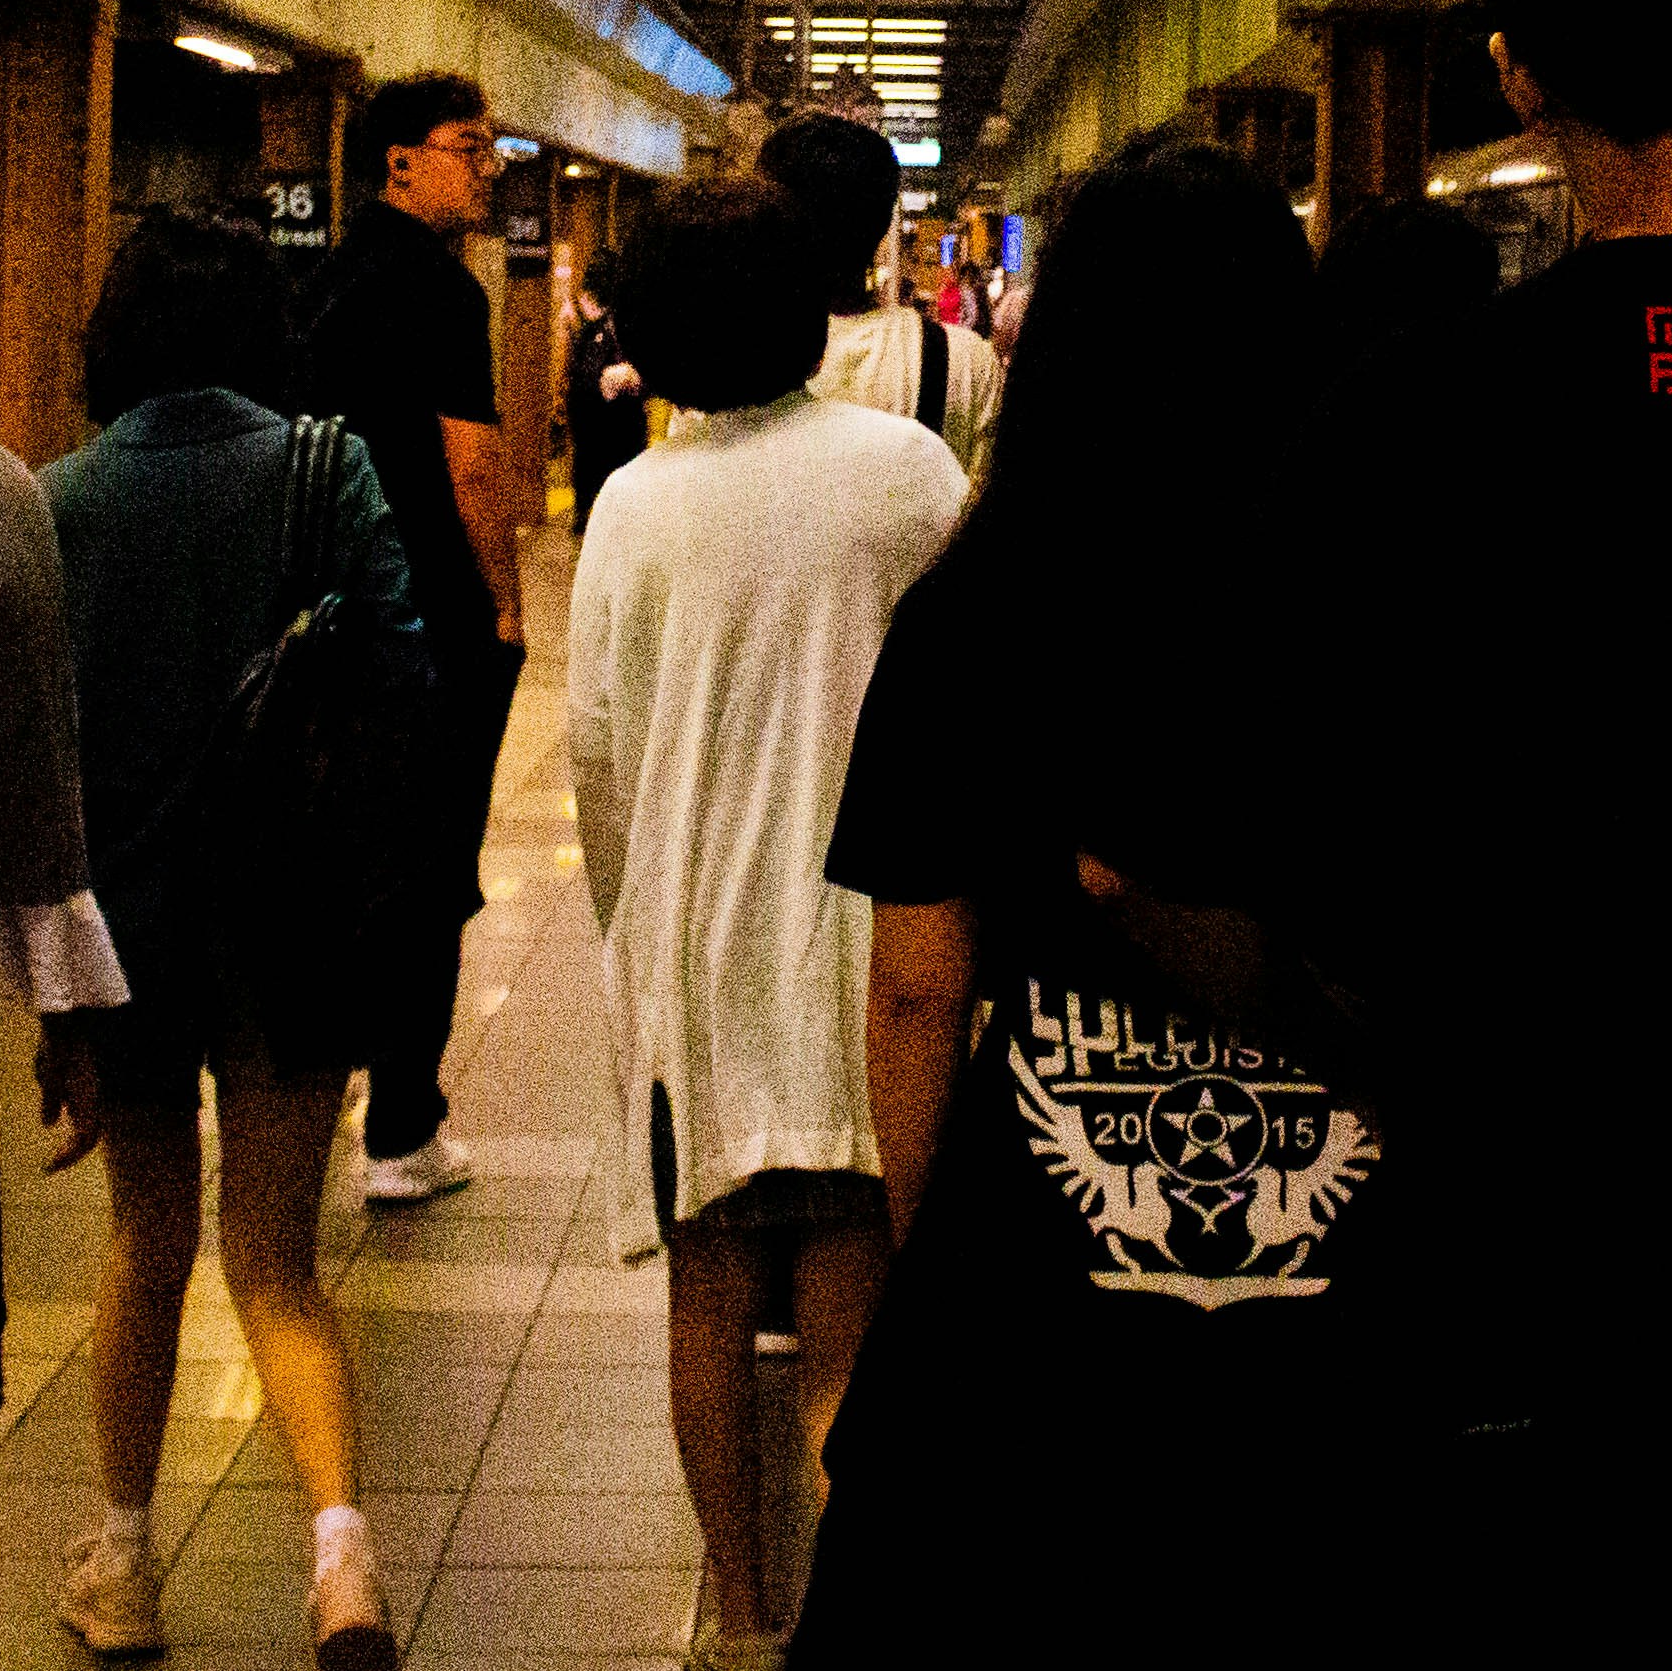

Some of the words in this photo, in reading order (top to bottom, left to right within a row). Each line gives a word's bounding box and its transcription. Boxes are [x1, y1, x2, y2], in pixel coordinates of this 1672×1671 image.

[263, 182, 314, 220] 36
[1093, 1110, 1143, 1148] 20
[1270, 1115, 1317, 1151] 15
